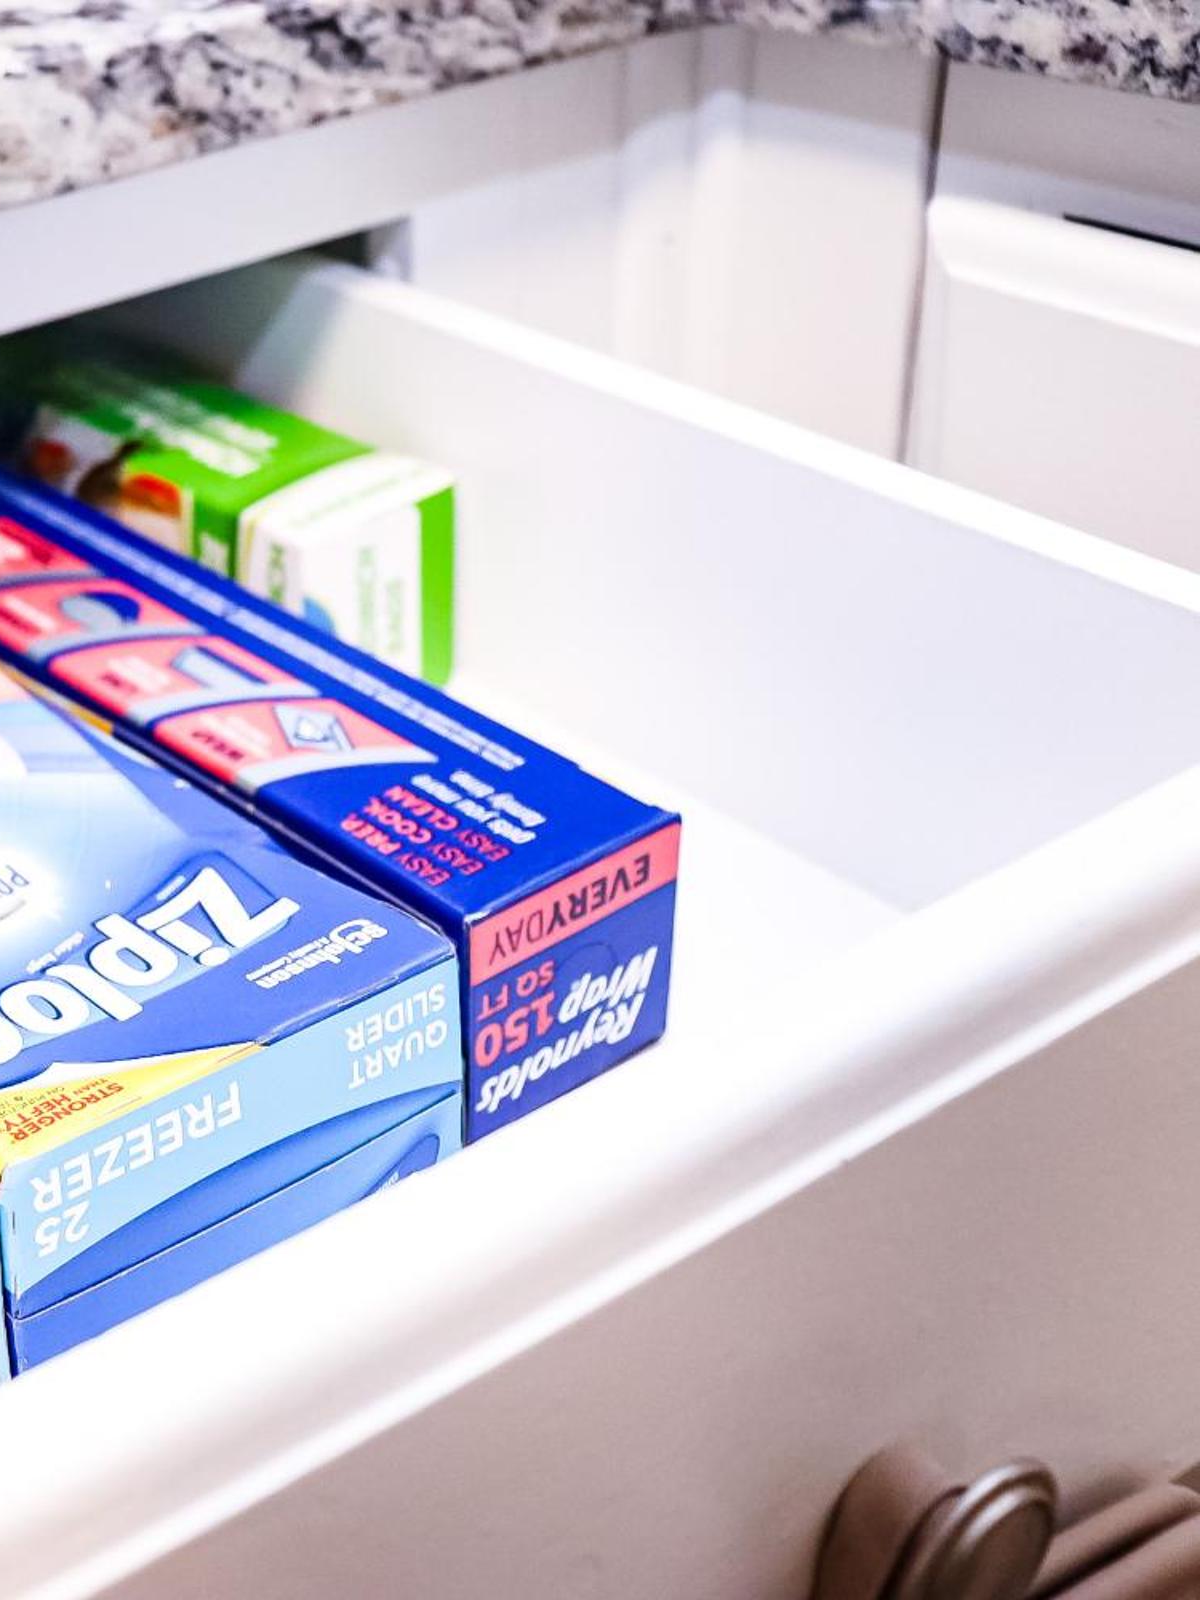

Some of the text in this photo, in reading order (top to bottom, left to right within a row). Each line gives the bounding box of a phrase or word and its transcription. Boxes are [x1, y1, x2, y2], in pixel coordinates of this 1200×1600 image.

[362, 797, 433, 844] COOK
[384, 785, 459, 831] CLEAN
[340, 812, 451, 887] EASY PREP
[427, 843, 484, 876] EASY
[455, 830, 510, 862] EASY
[487, 854, 650, 967] EVERYDAY
[345, 982, 446, 1053] SLIDER
[476, 960, 554, 1021] SQ FT
[557, 945, 658, 1024] Wrap
[348, 1018, 448, 1089] QUART
[474, 990, 555, 1067] 150
[474, 992, 646, 1114] Reynolds
[1, 1092, 71, 1132] HEFTY
[9, 1080, 125, 1143] STRONGER
[29, 1080, 243, 1213] FREEZER
[33, 1198, 91, 1258] 25
